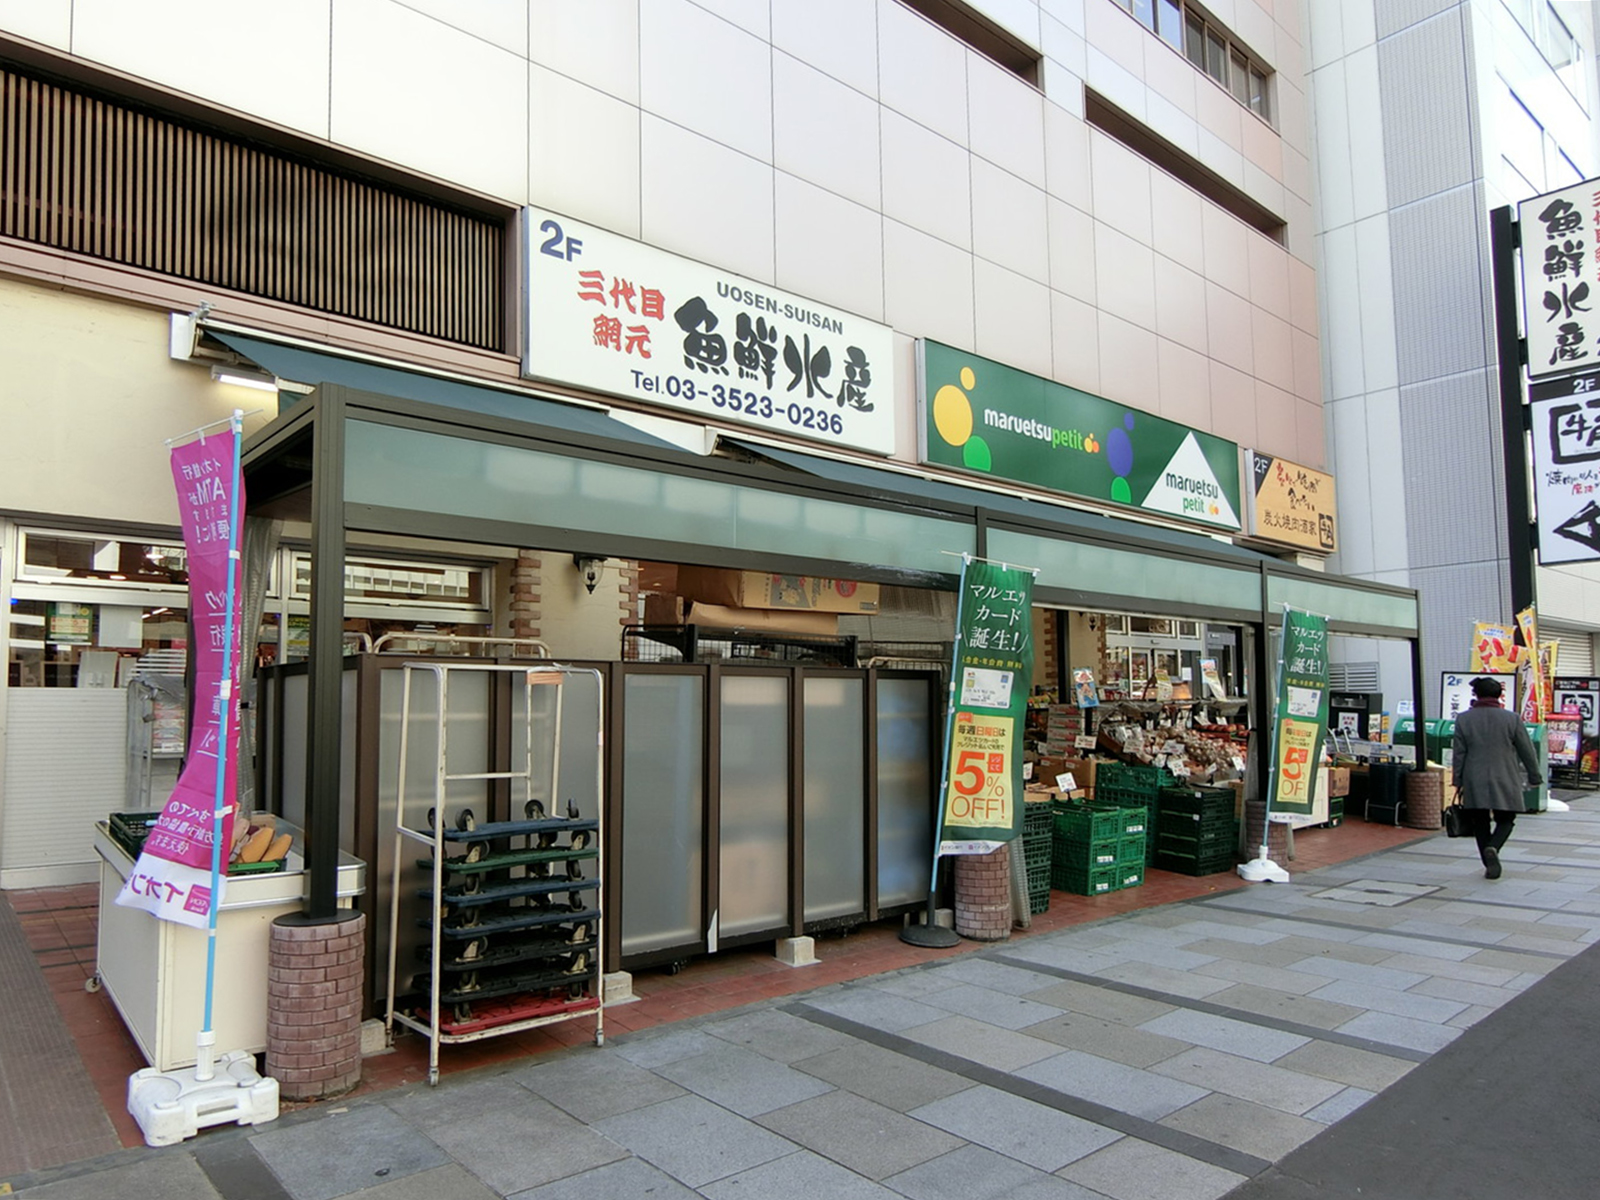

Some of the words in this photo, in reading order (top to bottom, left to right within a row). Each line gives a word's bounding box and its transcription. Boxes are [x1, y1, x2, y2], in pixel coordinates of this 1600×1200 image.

[540, 219, 583, 262] 2F
[1539, 198, 1592, 365] 魚鮮水産
[577, 269, 666, 321] 三代目
[717, 281, 843, 335] UOSEN-SUISAN
[592, 314, 652, 359] 網元
[674, 295, 875, 412] 魚鮮水産
[1573, 378, 1596, 394] 2F
[630, 369, 843, 436] Tel.03-3523-0236
[1254, 457, 1268, 474] 2F
[1166, 471, 1219, 500] maruetsu
[1183, 496, 1205, 515] petit
[970, 584, 1026, 606] マルエツ
[974, 604, 1022, 626] カード
[1290, 626, 1325, 642] マルエツ
[1295, 641, 1321, 656] カード
[1447, 675, 1462, 686] 2F
[958, 724, 1006, 738] 毎週日曜日は
[951, 795, 1005, 820] OFF!
